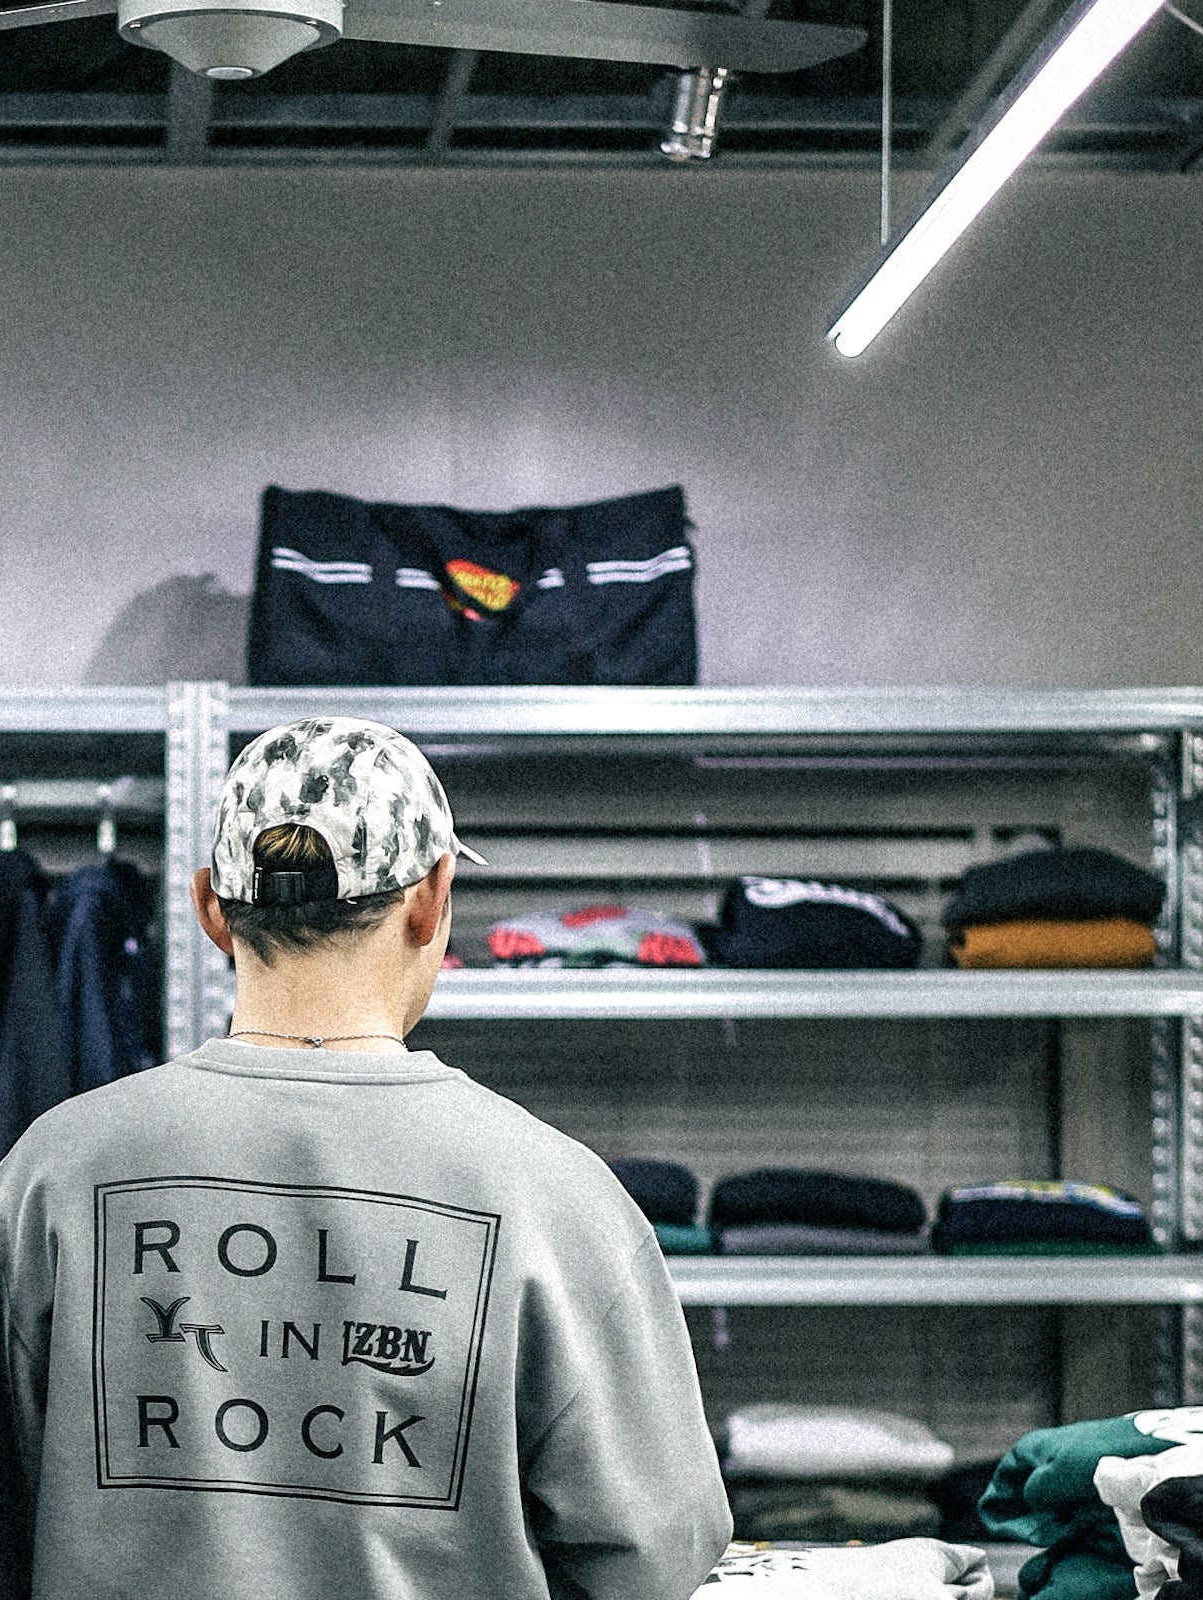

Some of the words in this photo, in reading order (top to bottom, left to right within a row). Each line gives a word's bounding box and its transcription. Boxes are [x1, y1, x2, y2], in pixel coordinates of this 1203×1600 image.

[132, 1219, 448, 1301] ROLL
[259, 1320, 322, 1361] IN
[135, 1394, 427, 1469] ROCK
